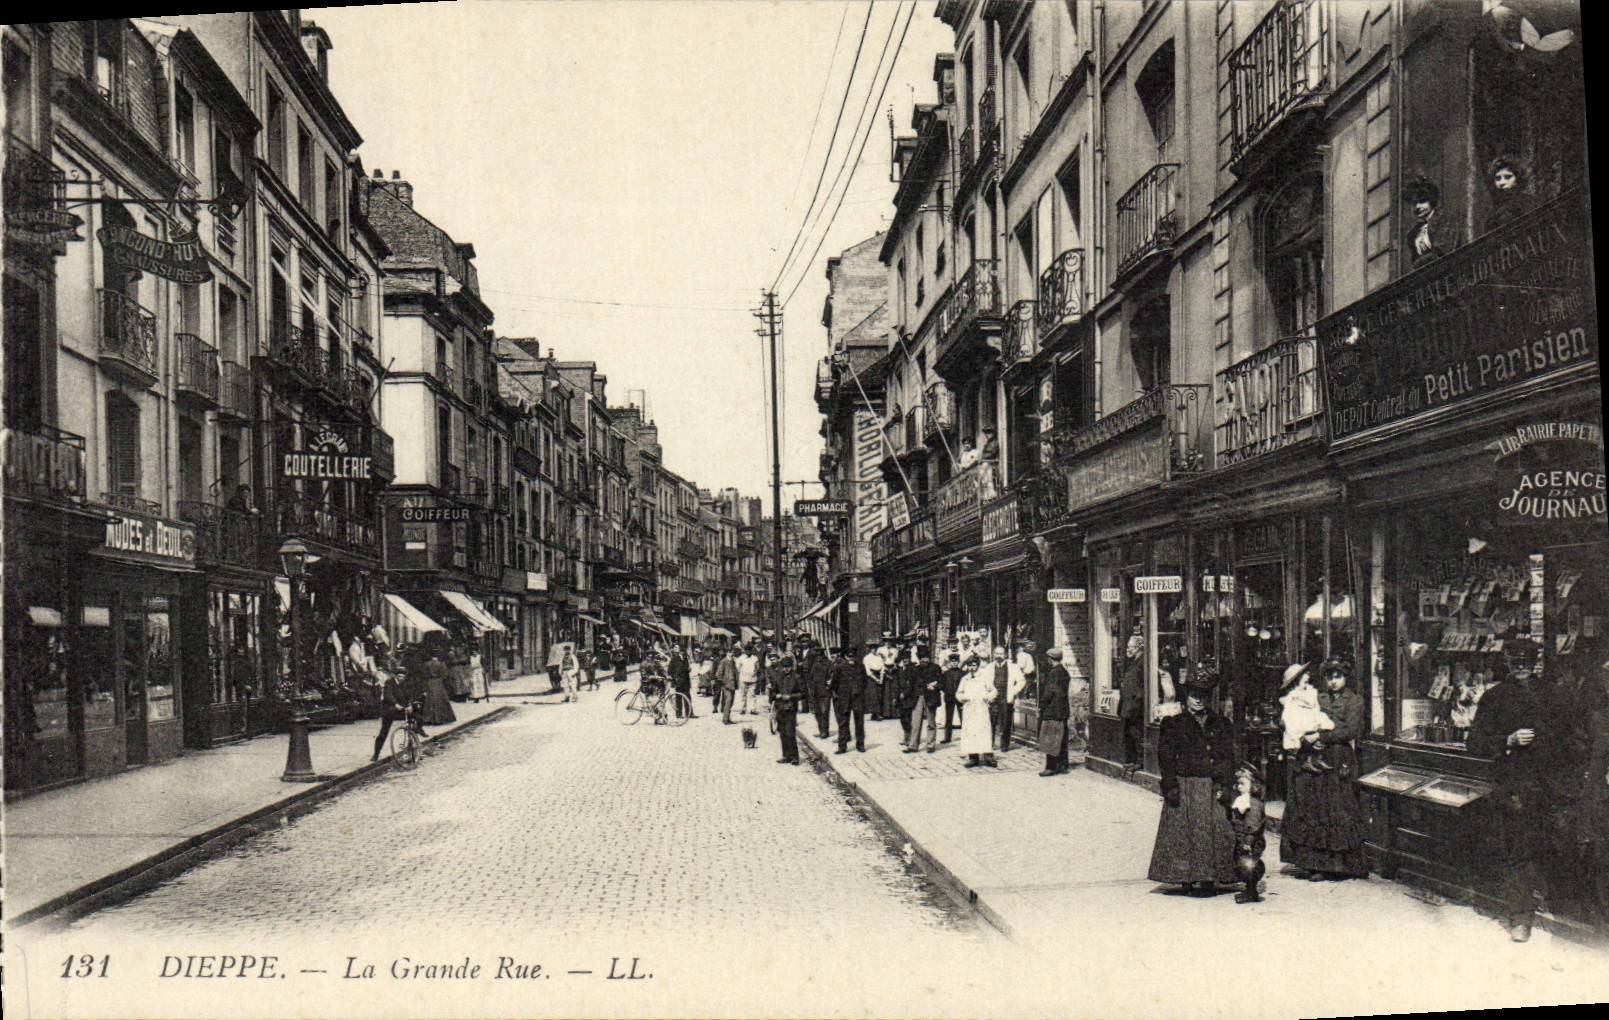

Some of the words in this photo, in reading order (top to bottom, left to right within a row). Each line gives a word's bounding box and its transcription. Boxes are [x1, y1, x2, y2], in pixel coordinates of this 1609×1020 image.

[1424, 361, 1473, 405] Petit
[1498, 423, 1557, 456] LIBRAIRIE
[284, 454, 371, 478] COUTELLERIE
[1520, 470, 1606, 490] AGENCE
[402, 508, 470, 521] COIFFEUR
[799, 502, 848, 513] PHARMACIE
[106, 517, 143, 552] MODES
[1136, 578, 1180, 592] COIFFEUR
[1048, 591, 1084, 601] COIFFEUR
